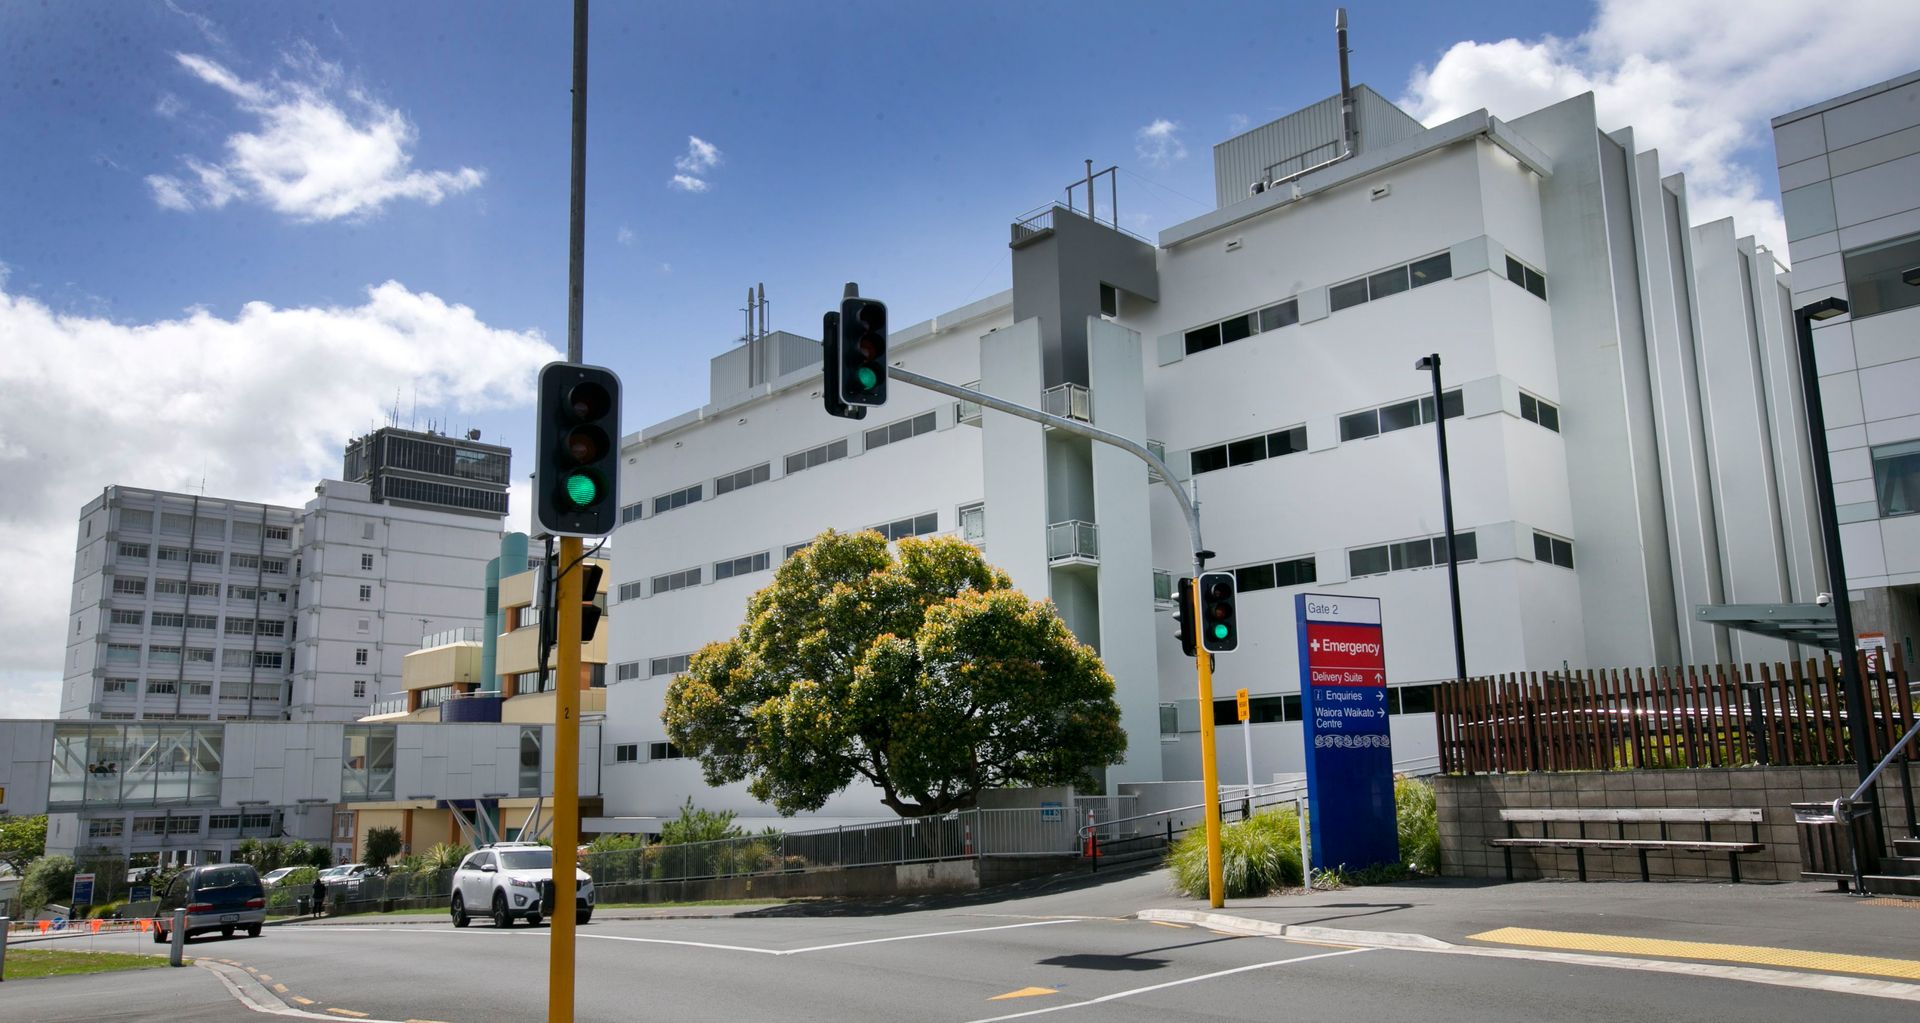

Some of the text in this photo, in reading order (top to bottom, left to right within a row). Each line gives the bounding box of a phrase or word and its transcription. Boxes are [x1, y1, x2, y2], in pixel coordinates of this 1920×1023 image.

[1307, 602, 1339, 615] Gate 2
[1322, 638, 1380, 657] Emergency
[1312, 671, 1363, 684] Delivery Suite
[1326, 690, 1363, 702] Enquiries
[564, 707, 570, 720] 2
[1315, 707, 1375, 718] Waiora Waikato
[1316, 718, 1343, 729] Centre
